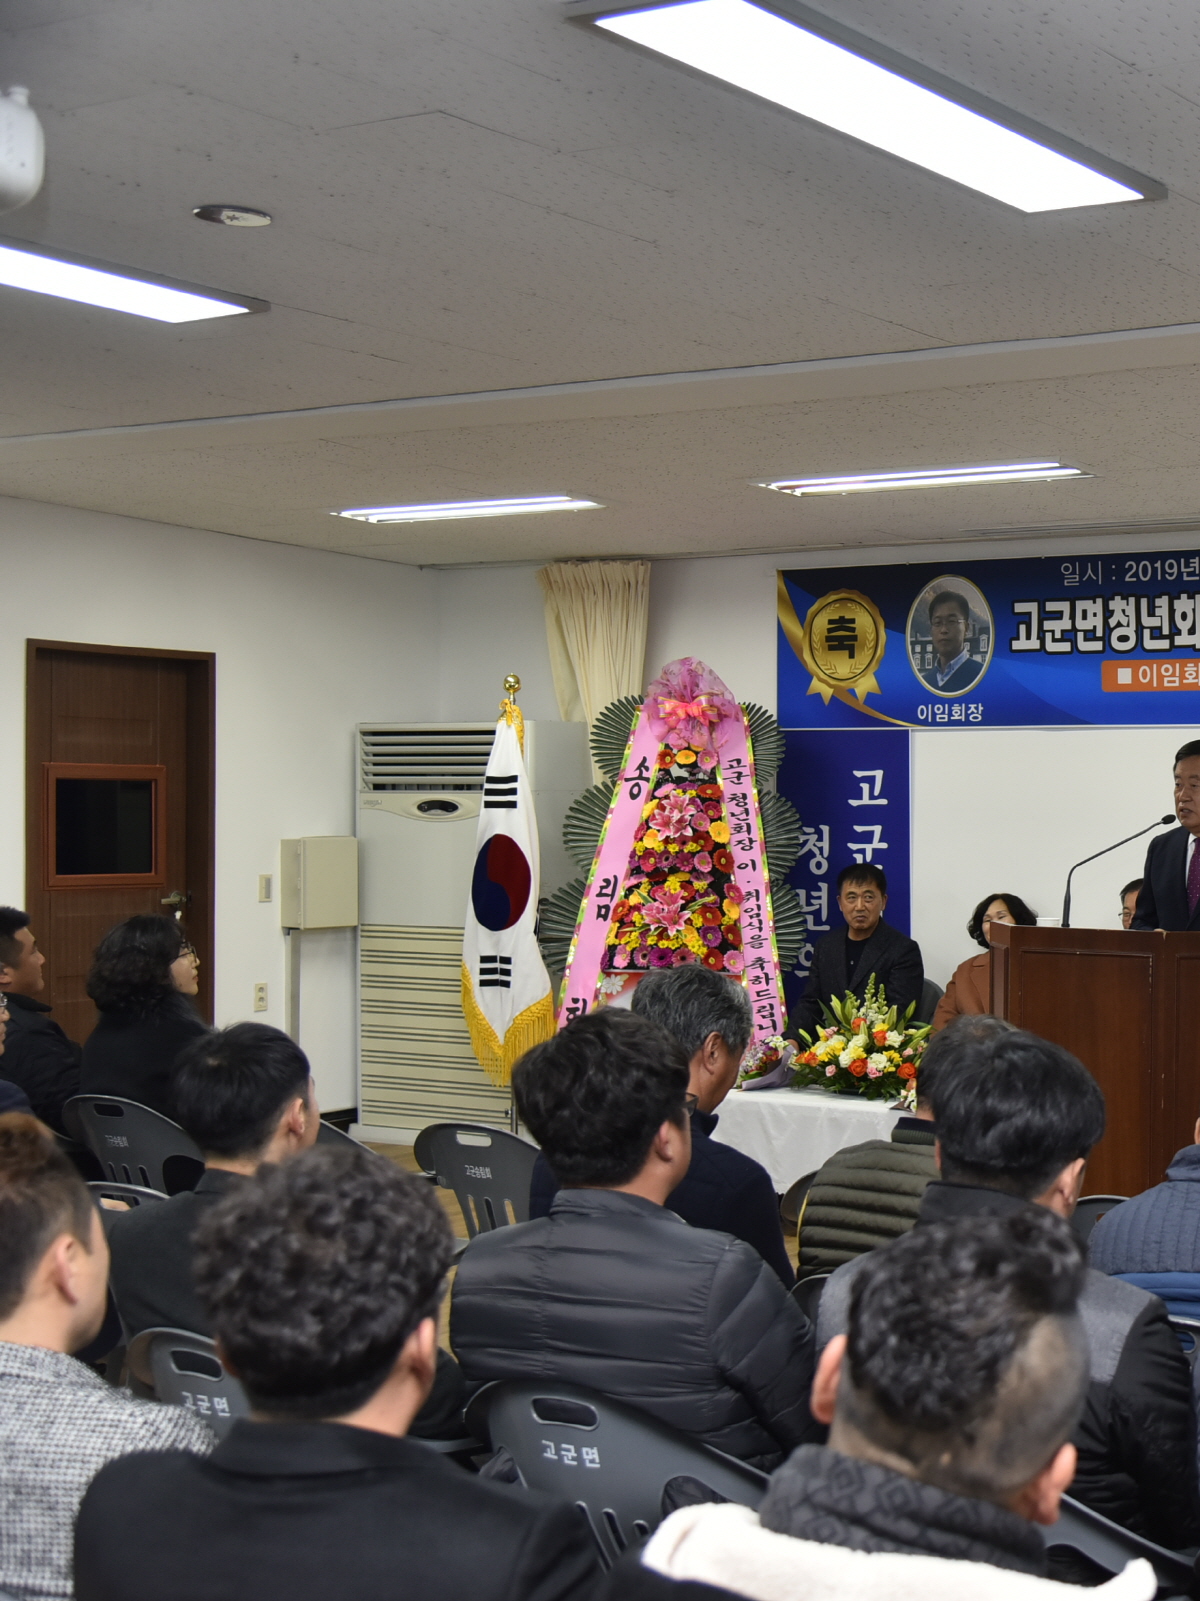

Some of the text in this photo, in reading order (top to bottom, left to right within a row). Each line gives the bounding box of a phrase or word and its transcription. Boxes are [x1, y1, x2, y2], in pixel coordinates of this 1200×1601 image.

[1061, 561, 1102, 586] 일시
[1124, 556, 1200, 581] 2019년
[825, 616, 858, 659] 축
[917, 703, 984, 722] 이임회장
[722, 758, 750, 785] 고군
[727, 792, 758, 851] 청년회장
[745, 957, 780, 1046] 축하드립니
[182, 1391, 231, 1417] 고군면
[541, 1439, 601, 1468] 고군면
